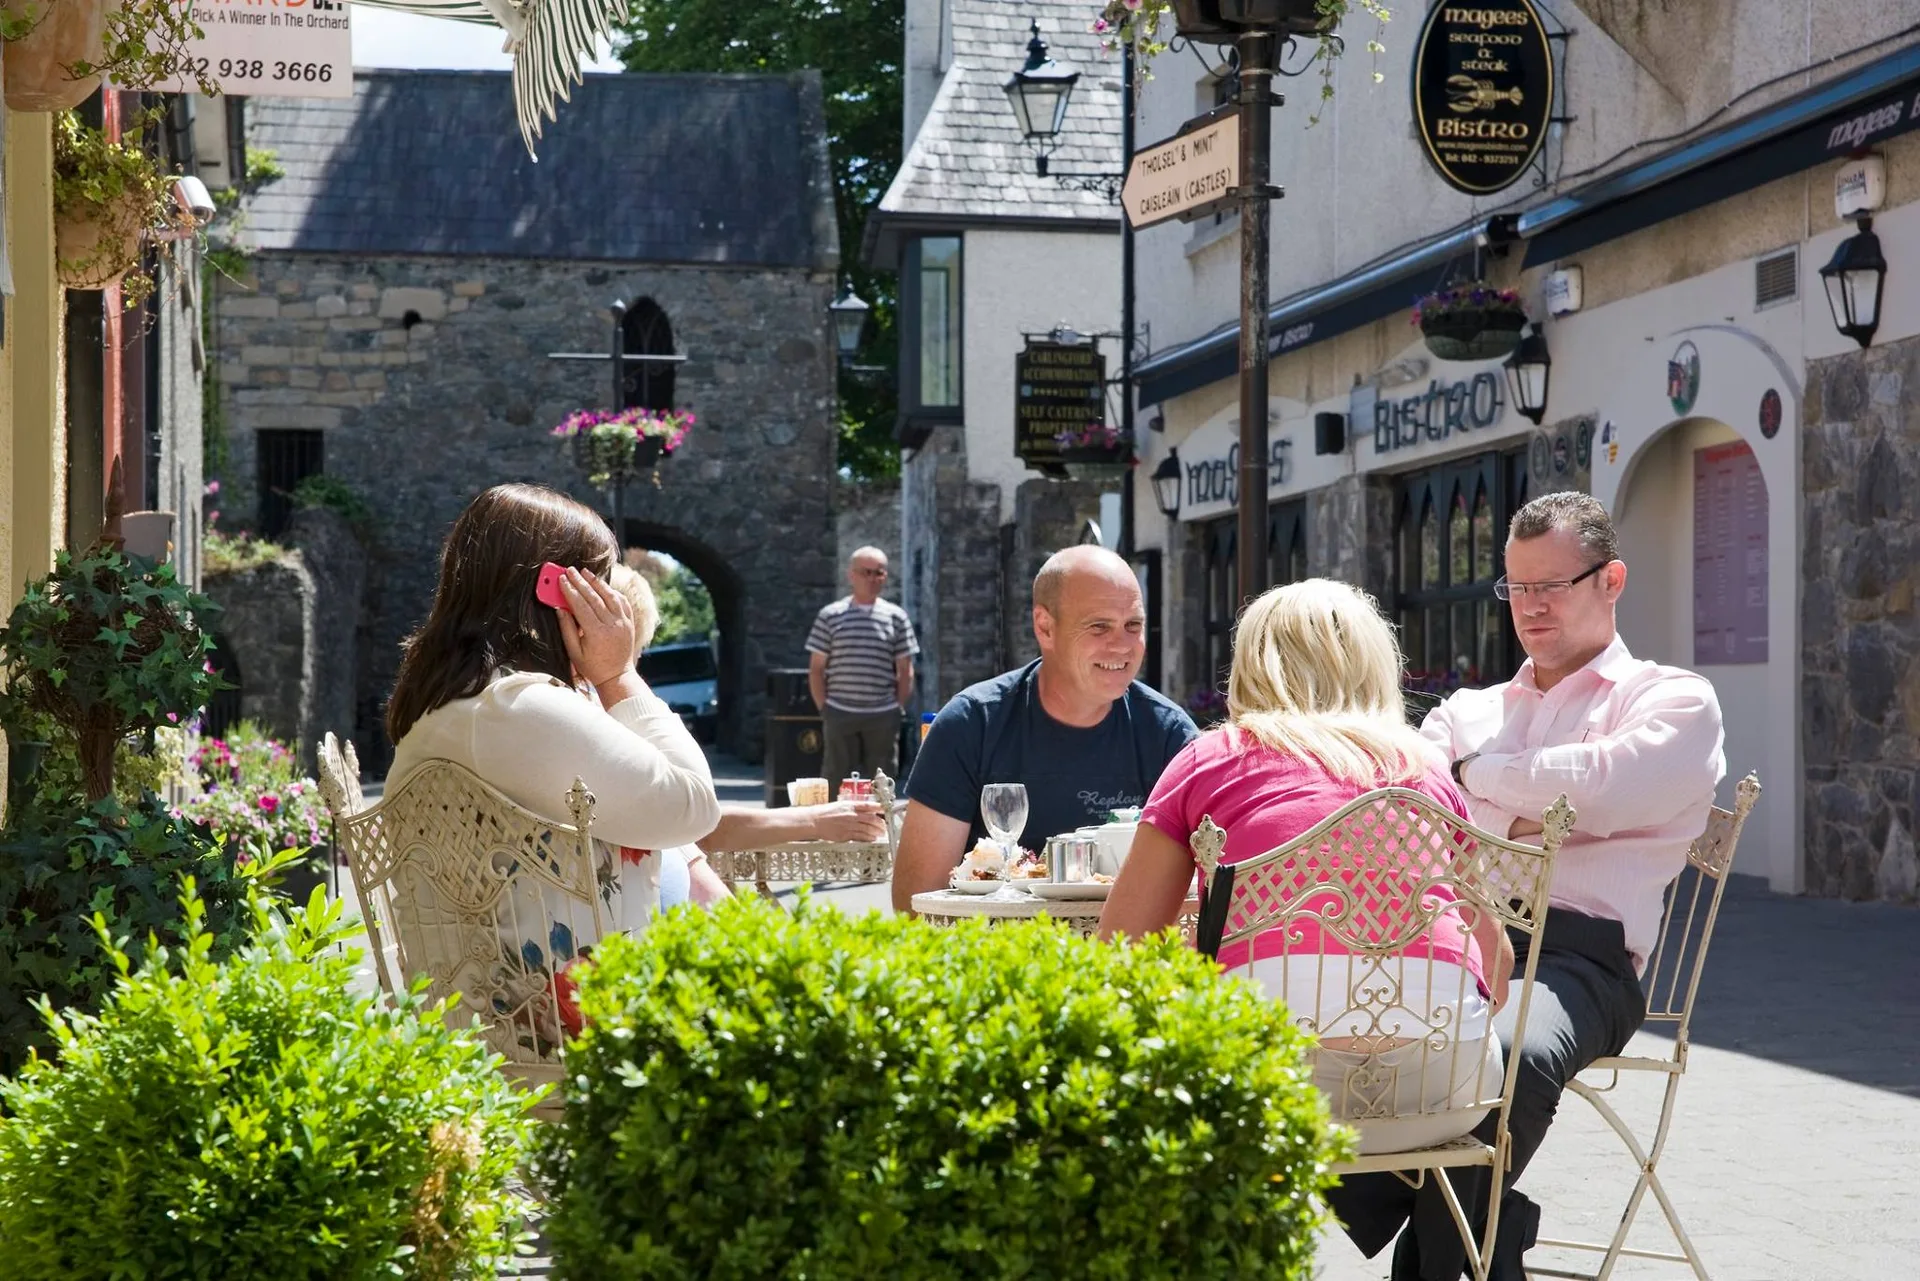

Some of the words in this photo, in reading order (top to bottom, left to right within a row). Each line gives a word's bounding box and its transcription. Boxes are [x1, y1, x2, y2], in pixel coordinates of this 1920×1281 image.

[192, 8, 216, 23] Pick
[218, 12, 227, 24] A
[229, 10, 267, 26] Winner
[270, 13, 281, 26] In
[284, 13, 304, 28] The
[306, 14, 349, 30] Orchard
[1444, 8, 1529, 30] magees
[218, 58, 263, 79] 938
[272, 61, 333, 83] 3666
[1461, 59, 1509, 72] steak
[1184, 166, 1232, 201] (CASTLES)
